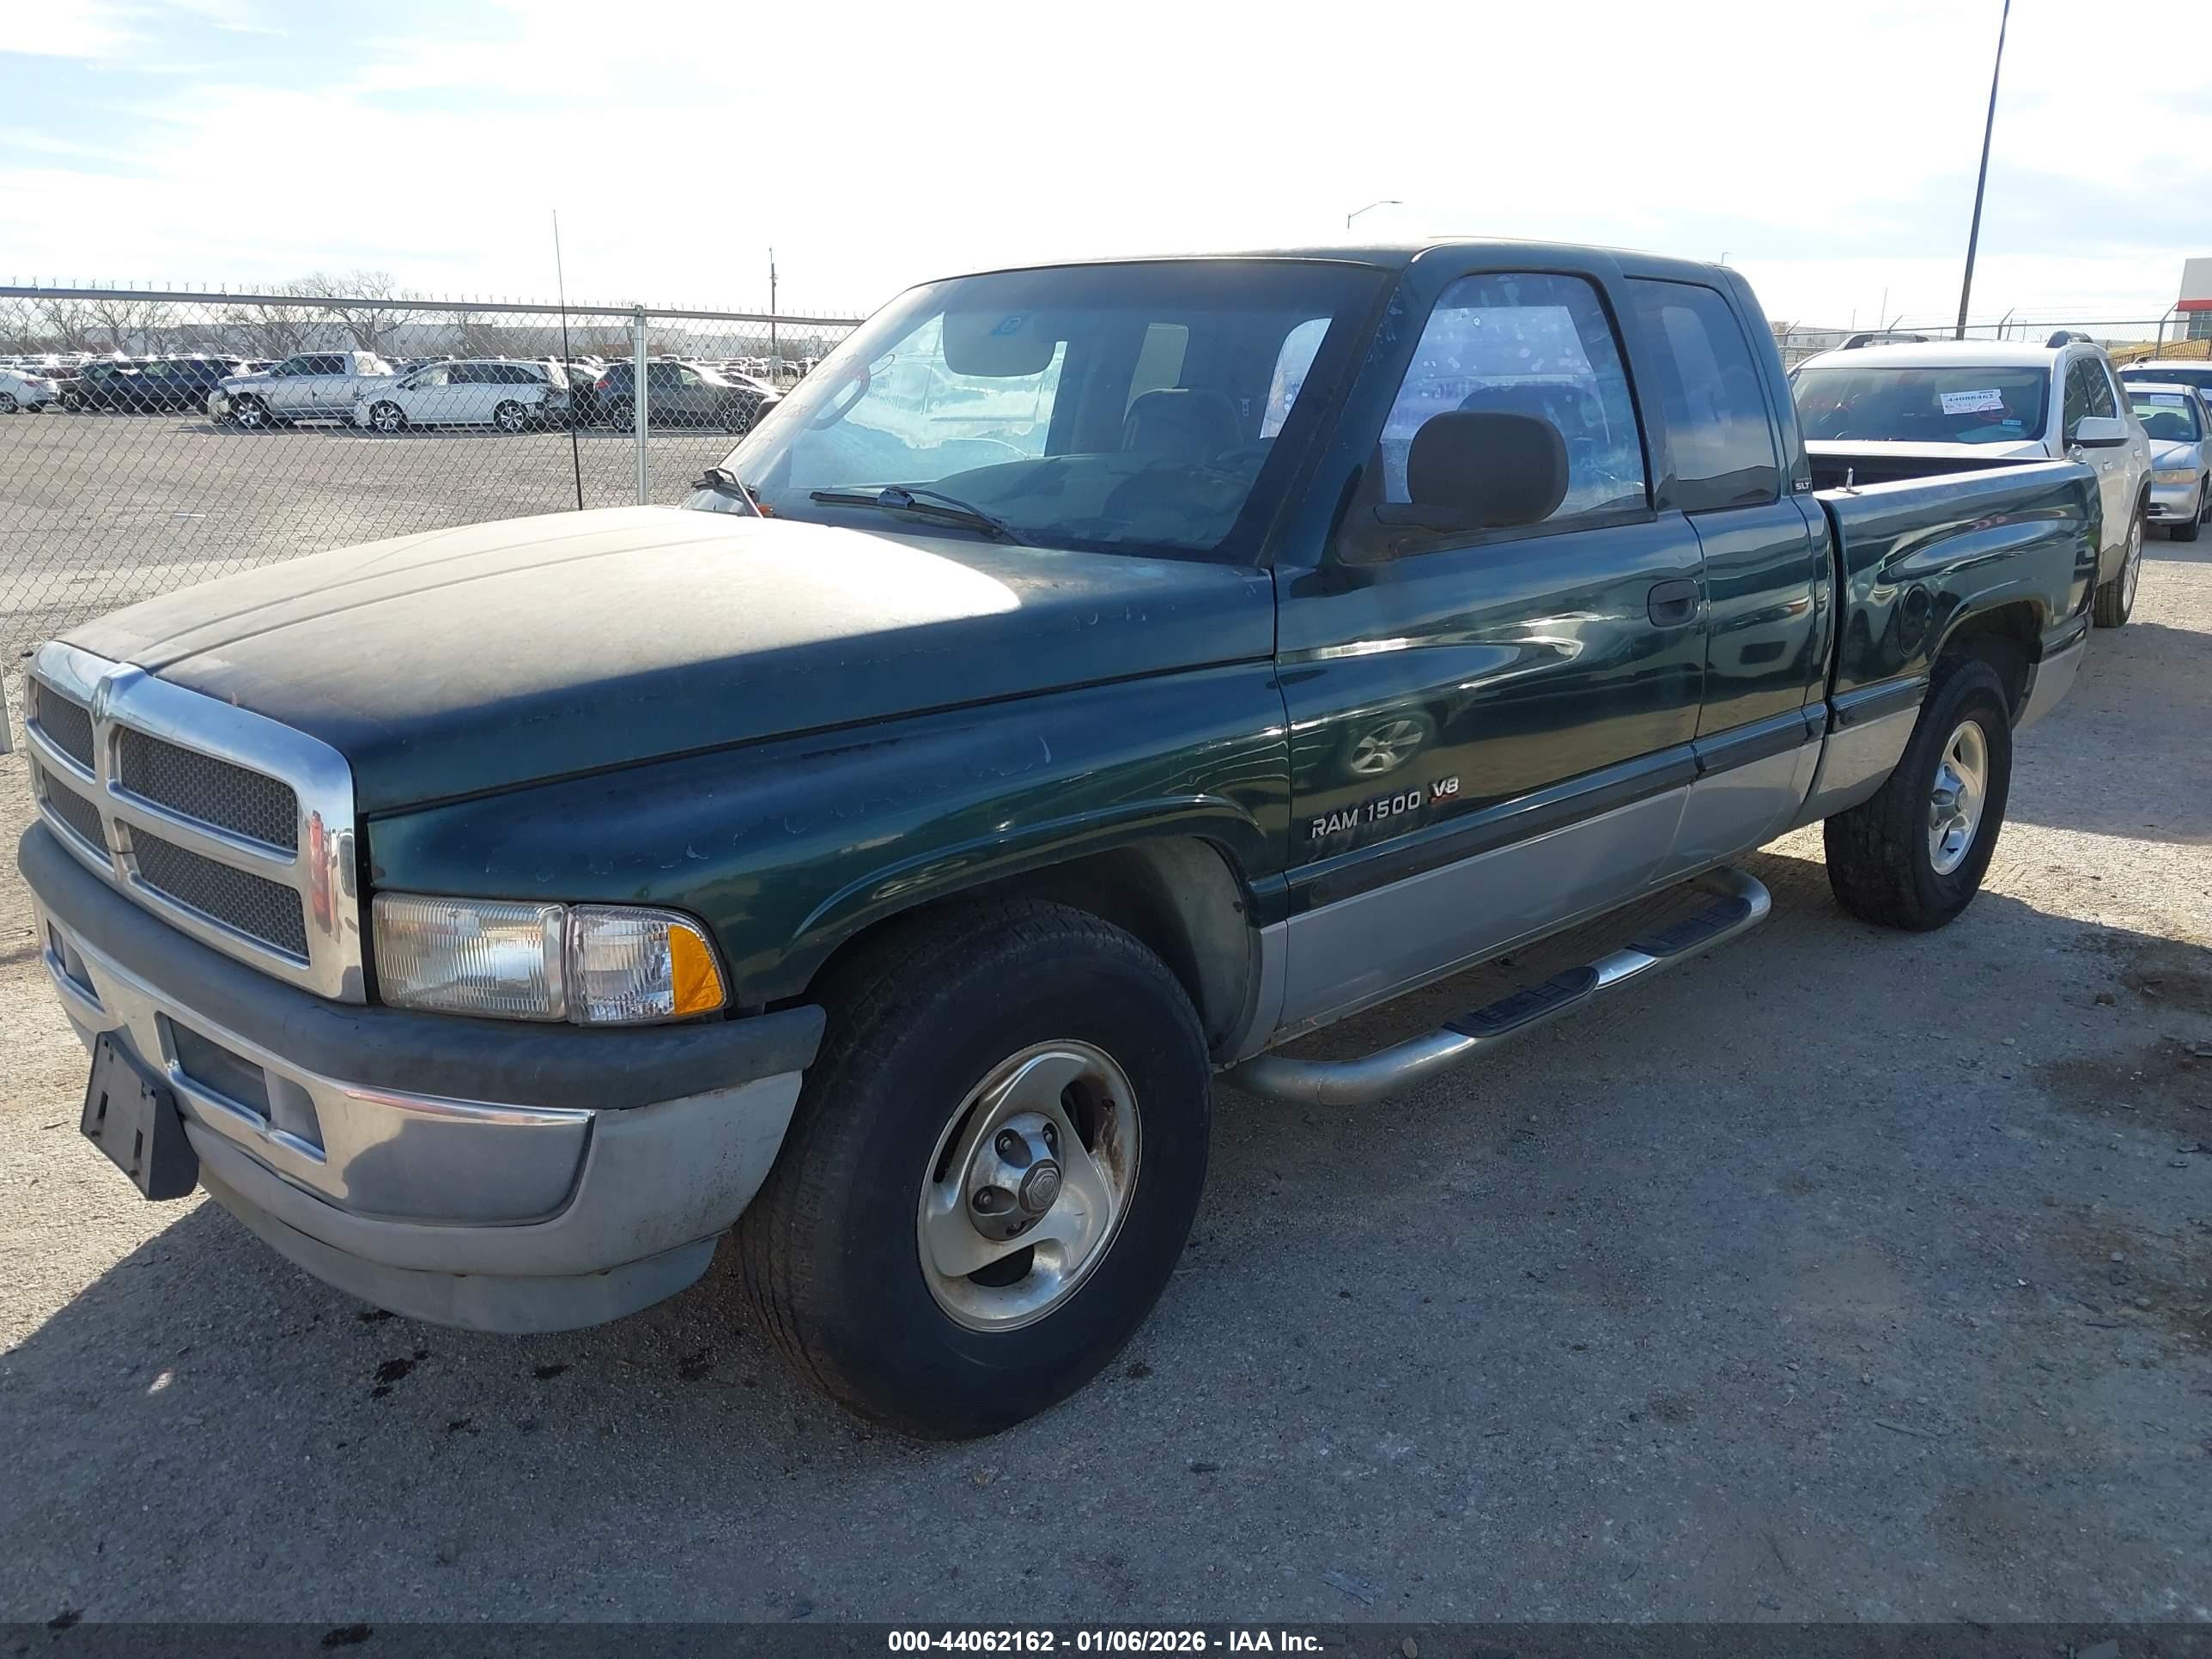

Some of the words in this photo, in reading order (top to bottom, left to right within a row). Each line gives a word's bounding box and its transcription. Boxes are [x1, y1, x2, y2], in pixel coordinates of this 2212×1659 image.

[1311, 808, 1358, 839] RAM
[1367, 791, 1421, 822] 1500
[1431, 776, 1460, 798] V8
